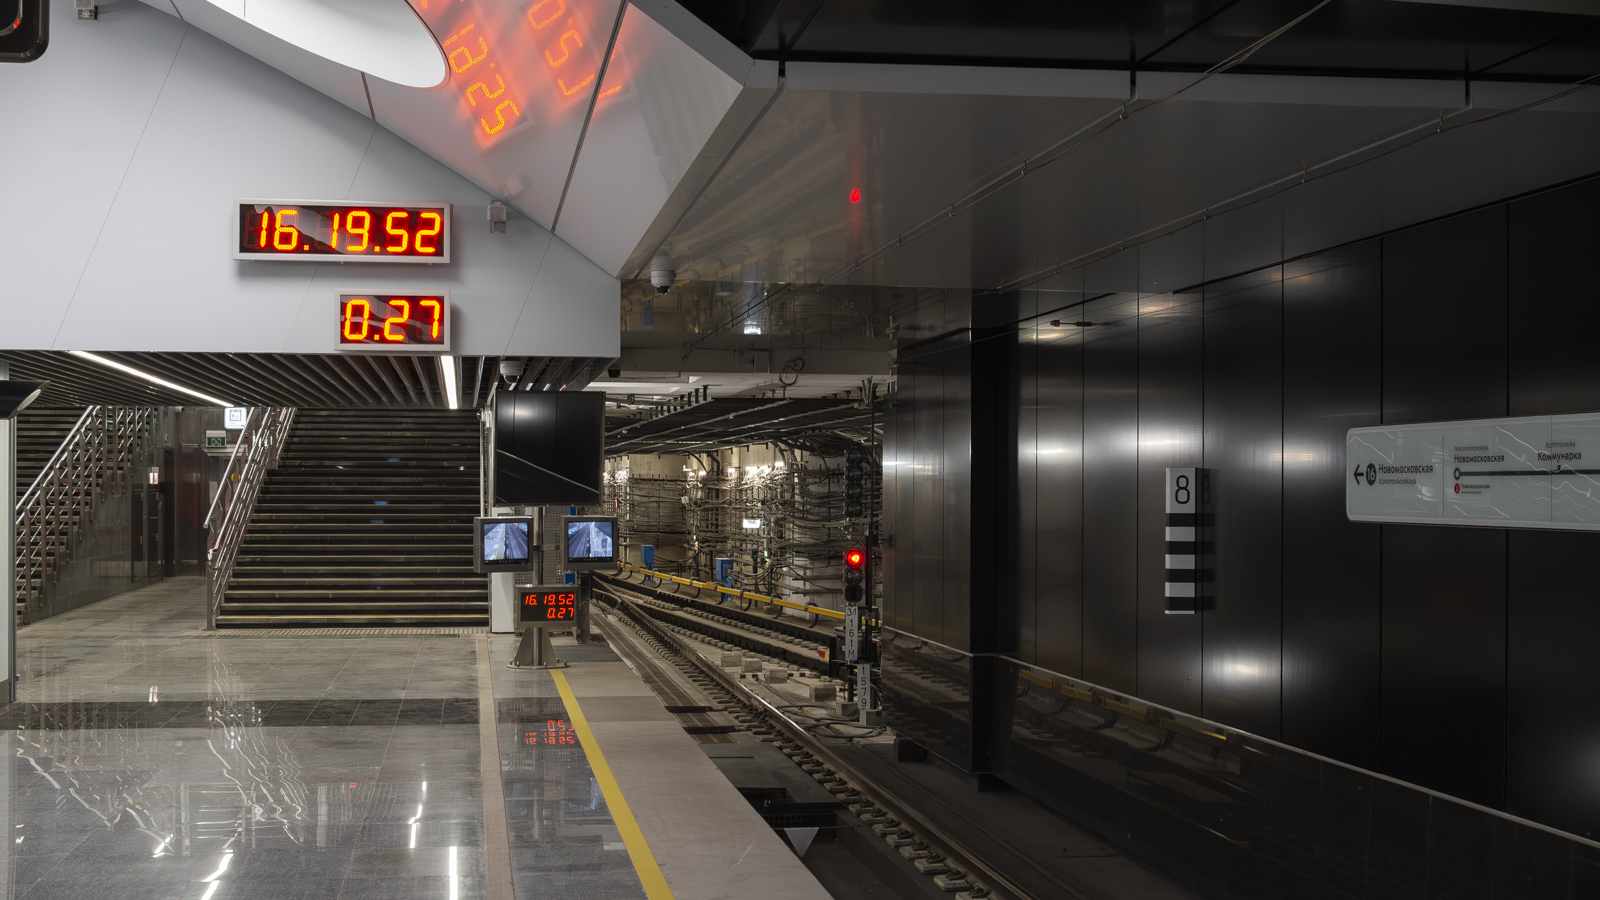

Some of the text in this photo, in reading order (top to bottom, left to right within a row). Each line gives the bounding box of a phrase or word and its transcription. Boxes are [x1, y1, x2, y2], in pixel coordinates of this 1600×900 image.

[260, 209, 442, 253] 16.19.52
[344, 299, 441, 341] 0.27
[1454, 454, 1505, 463] Новомосковская
[1537, 451, 1582, 463] Коммунарка
[1367, 467, 1376, 481] 16
[1378, 463, 1434, 474] Новомосковская
[1378, 477, 1417, 486] Novomoskovskaya
[1174, 474, 1191, 505] 8
[547, 607, 575, 619] 0.27
[860, 666, 868, 708] 1579
